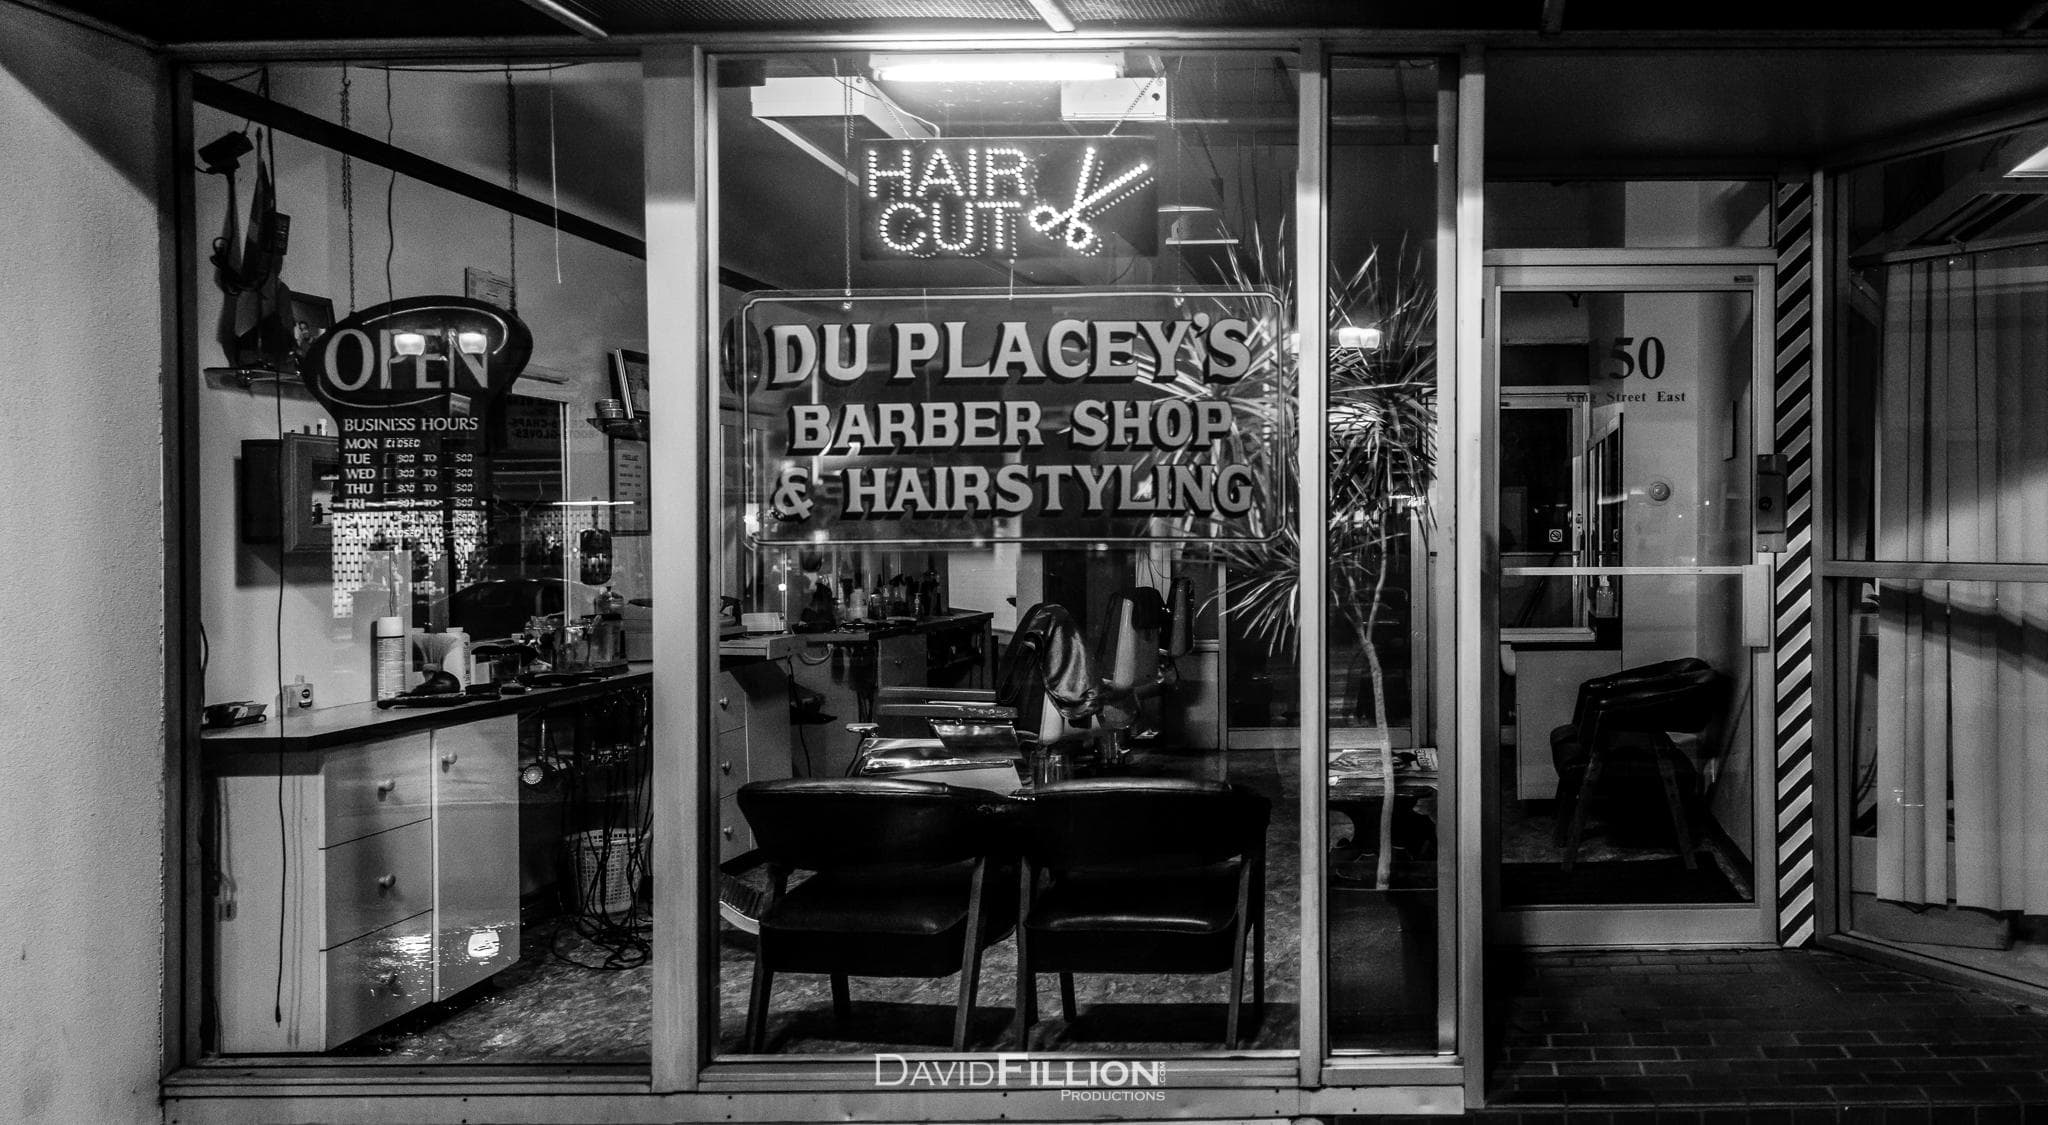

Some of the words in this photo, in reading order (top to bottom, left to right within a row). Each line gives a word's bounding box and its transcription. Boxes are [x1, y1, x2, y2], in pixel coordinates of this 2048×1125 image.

[868, 148, 1028, 198] HAIR
[878, 202, 1022, 251] CUT
[324, 328, 488, 391] OPEN
[767, 321, 871, 387] DU
[890, 313, 1252, 385] PLACEY'S
[1608, 336, 1665, 380] 50
[1607, 391, 1646, 402] Street
[1657, 390, 1686, 402] East
[344, 417, 416, 431] BUSINESS
[421, 417, 479, 431] HOURS
[787, 400, 1044, 455] BARBER
[1067, 400, 1234, 453] SHOP
[344, 438, 378, 449] MON
[385, 438, 421, 448] CLOSED
[344, 453, 371, 464] TUE
[423, 454, 437, 463] TO
[345, 468, 376, 479] WED
[423, 469, 437, 478] TO
[344, 483, 374, 494] THU
[772, 466, 814, 520] &
[841, 464, 1255, 519] HAIRSTYLING
[345, 498, 365, 509] FRI
